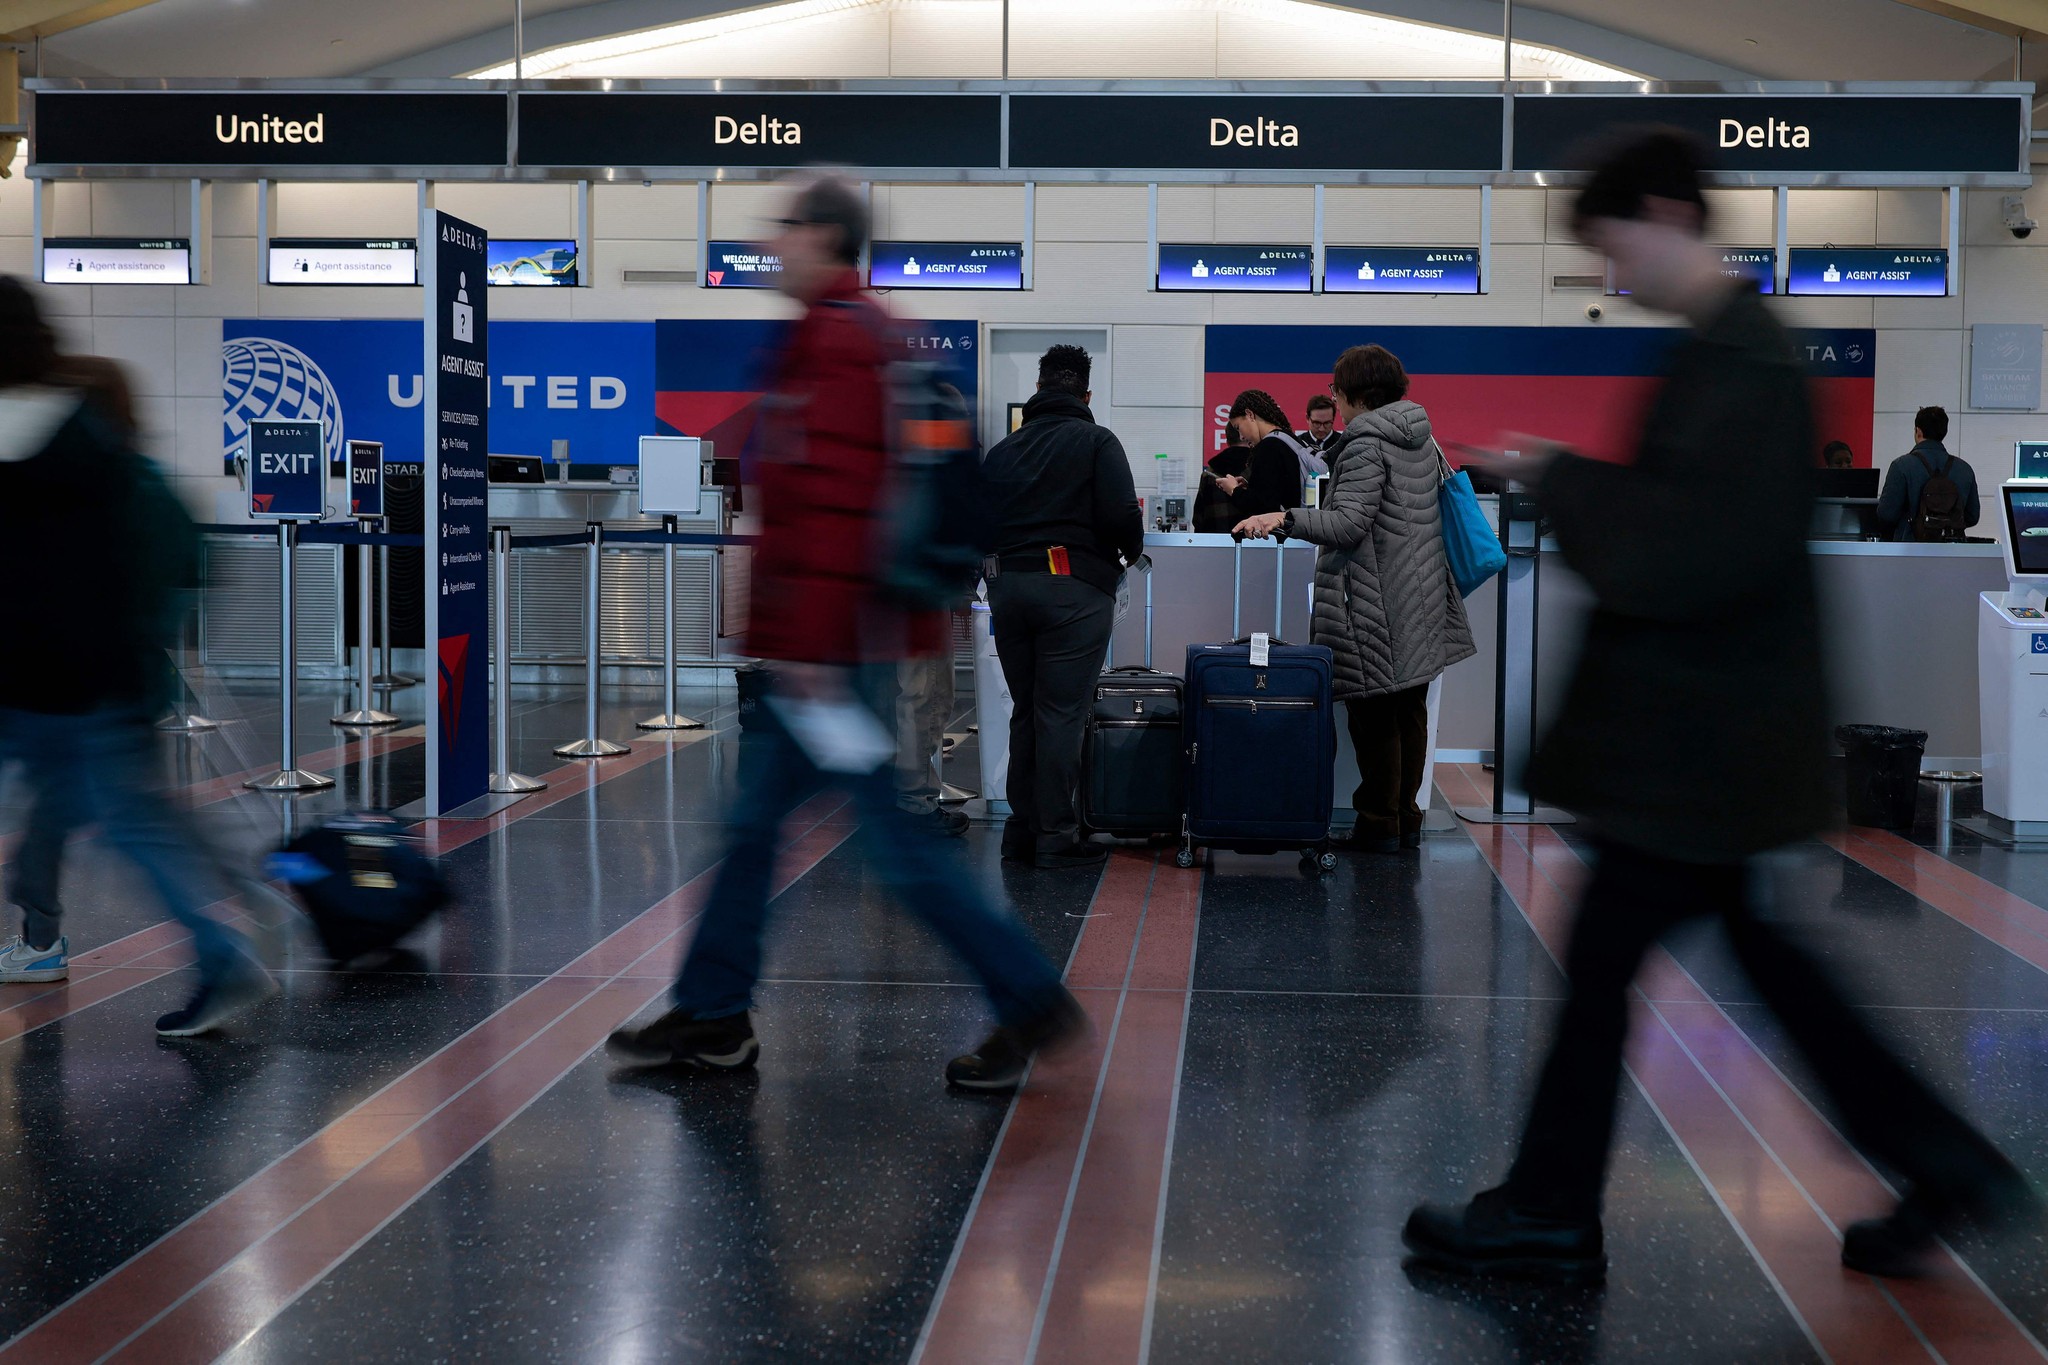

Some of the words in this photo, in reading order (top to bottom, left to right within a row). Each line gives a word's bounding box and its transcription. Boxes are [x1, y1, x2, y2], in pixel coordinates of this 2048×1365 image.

[216, 112, 325, 145] United
[714, 114, 802, 146] Delta
[1210, 116, 1300, 147] Delta
[1719, 117, 1811, 149] Delta
[450, 226, 476, 251] DELTA
[722, 254, 760, 264] WELCOME
[979, 249, 1008, 257] DELTA
[1268, 252, 1298, 260] DELTA
[1435, 254, 1465, 262] DELTA
[1731, 254, 1761, 263] DELTA
[1903, 255, 1933, 264] DELTA
[88, 260, 116, 272] Agent
[118, 260, 166, 271] assistance
[314, 260, 342, 272] Agent
[344, 260, 392, 271] assistance
[733, 263, 756, 272] THANK
[757, 264, 771, 273] YOU
[925, 264, 956, 274] AGENT
[957, 264, 988, 274] ASSIST
[1213, 266, 1246, 277] AGENT
[1247, 266, 1278, 277] ASSIST
[1379, 268, 1412, 279] AGENT
[1413, 268, 1445, 279] ASSIST
[1845, 270, 1879, 281] AGENT
[1880, 270, 1912, 281] ASSIST
[906, 336, 954, 349] ELTA
[441, 354, 464, 375] AGENT
[464, 359, 485, 379] ASSIST
[388, 374, 627, 410] UTED
[441, 410, 461, 424] SERVICES
[273, 429, 302, 437] DELTA
[260, 453, 315, 475] EXIT
[384, 464, 418, 476] STAR
[353, 467, 378, 485] EXIT
